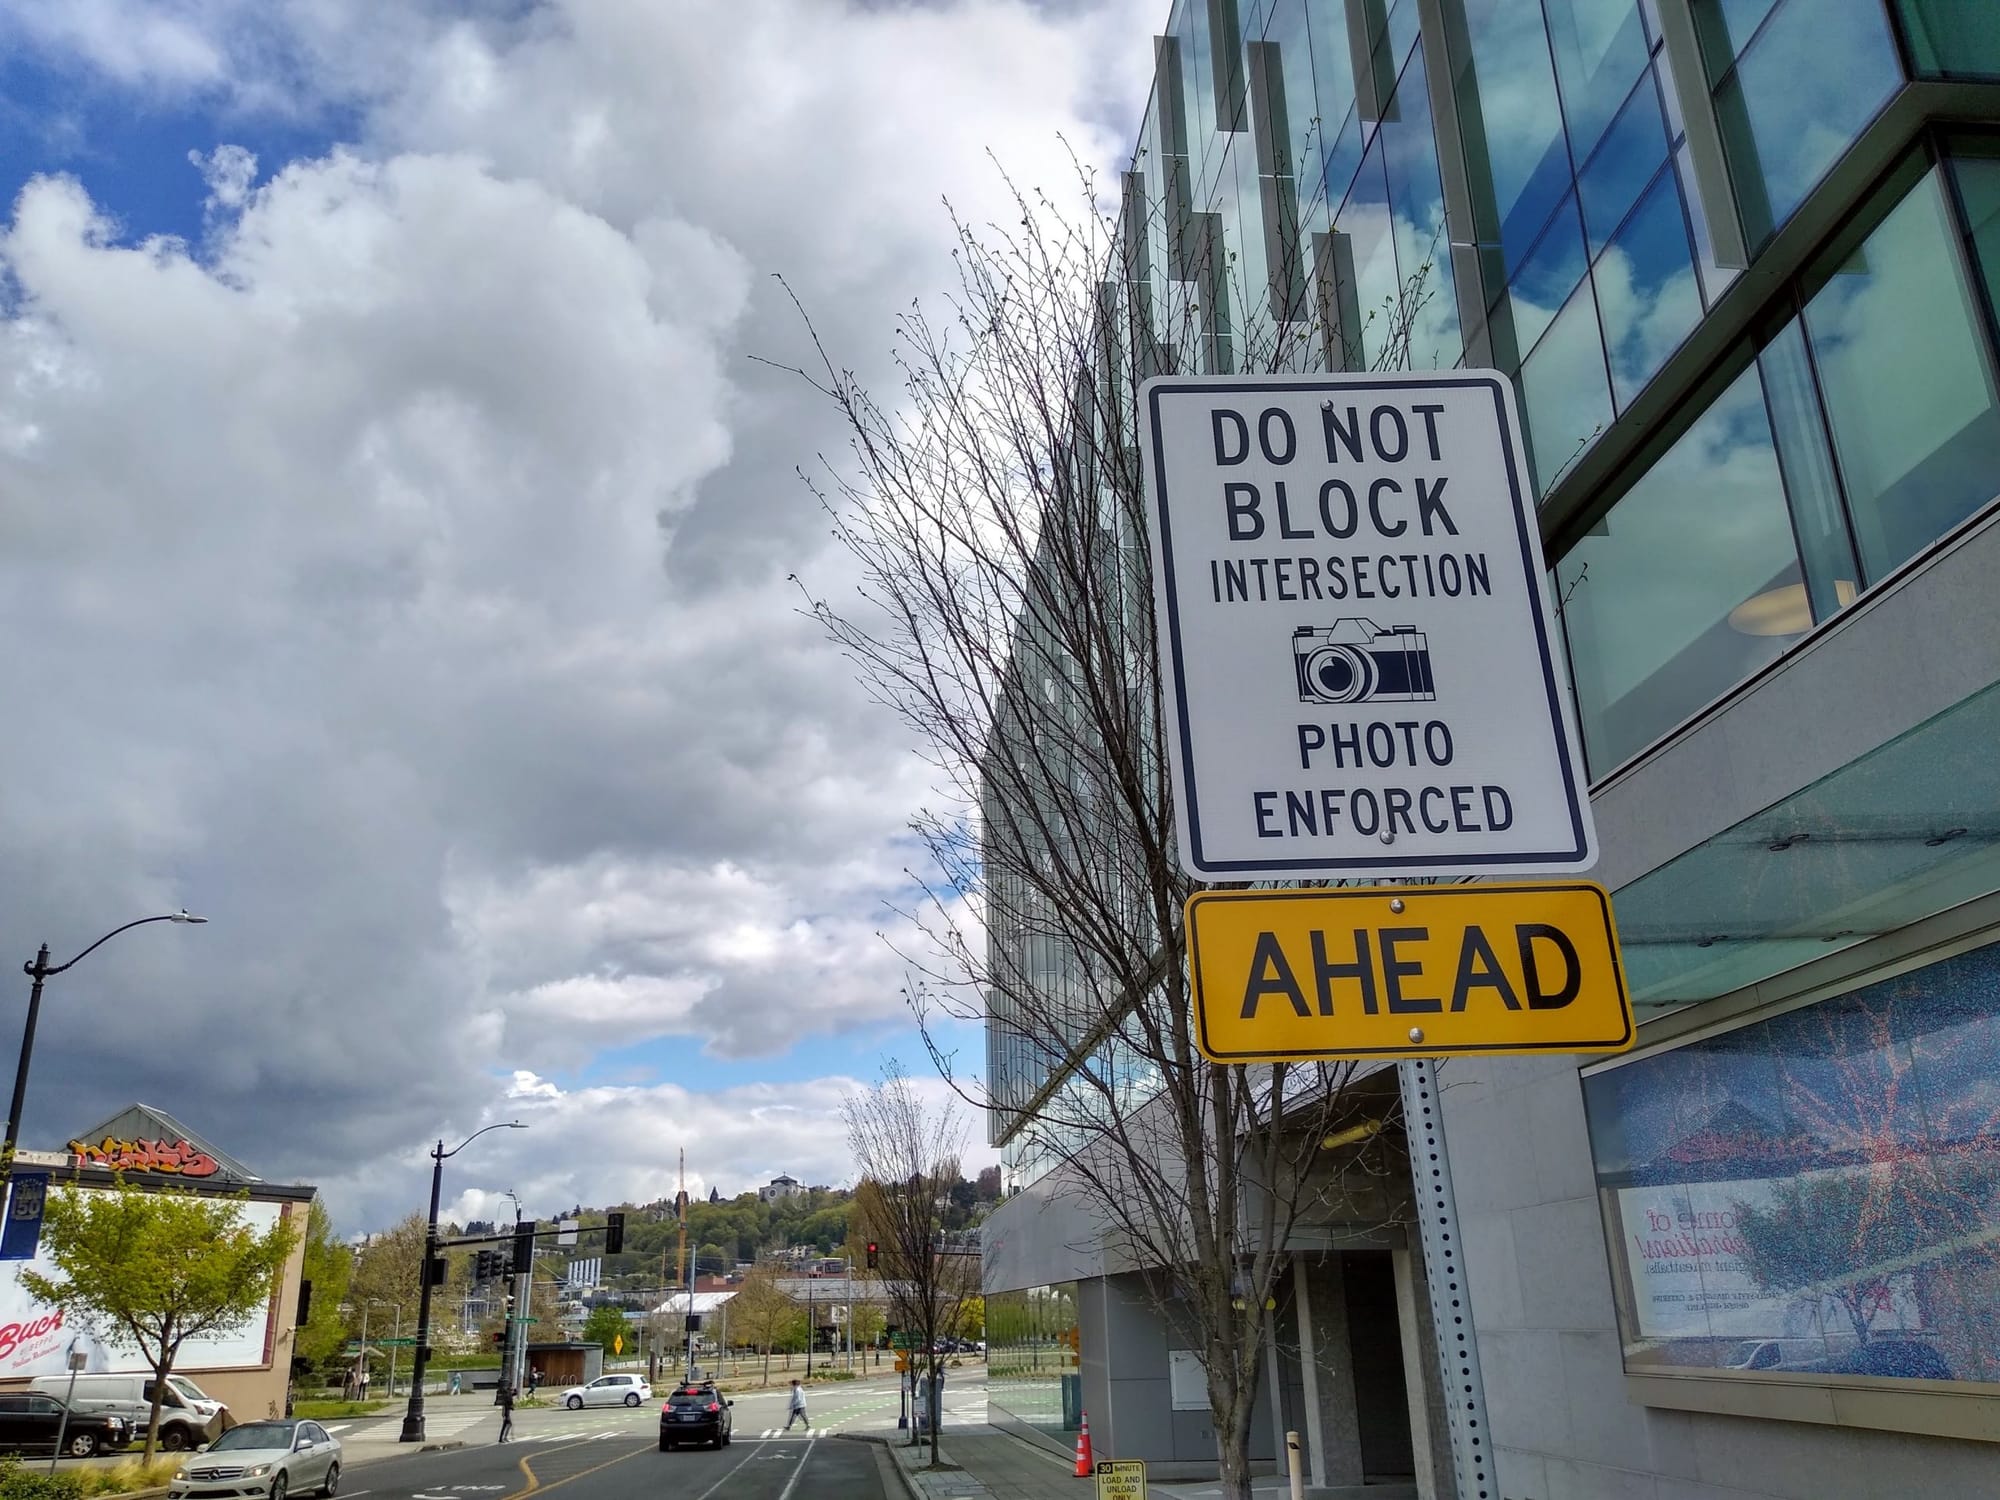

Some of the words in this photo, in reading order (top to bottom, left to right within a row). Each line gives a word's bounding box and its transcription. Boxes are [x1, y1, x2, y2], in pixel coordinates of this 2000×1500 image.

[1210, 407, 1297, 466] DO
[1321, 404, 1446, 464] NOT
[1223, 476, 1460, 542] BLOCK
[1210, 552, 1493, 603] INTERSECTION
[1296, 719, 1455, 770] PHOTO
[1253, 784, 1514, 839] ENFORCED
[1239, 923, 1582, 1019] AHEAD
[16, 1199, 40, 1216] 50
[1100, 1464, 1112, 1473] 30
[1102, 1476, 1121, 1484] LOAD
[1106, 1485, 1137, 1493] UNLOAD
